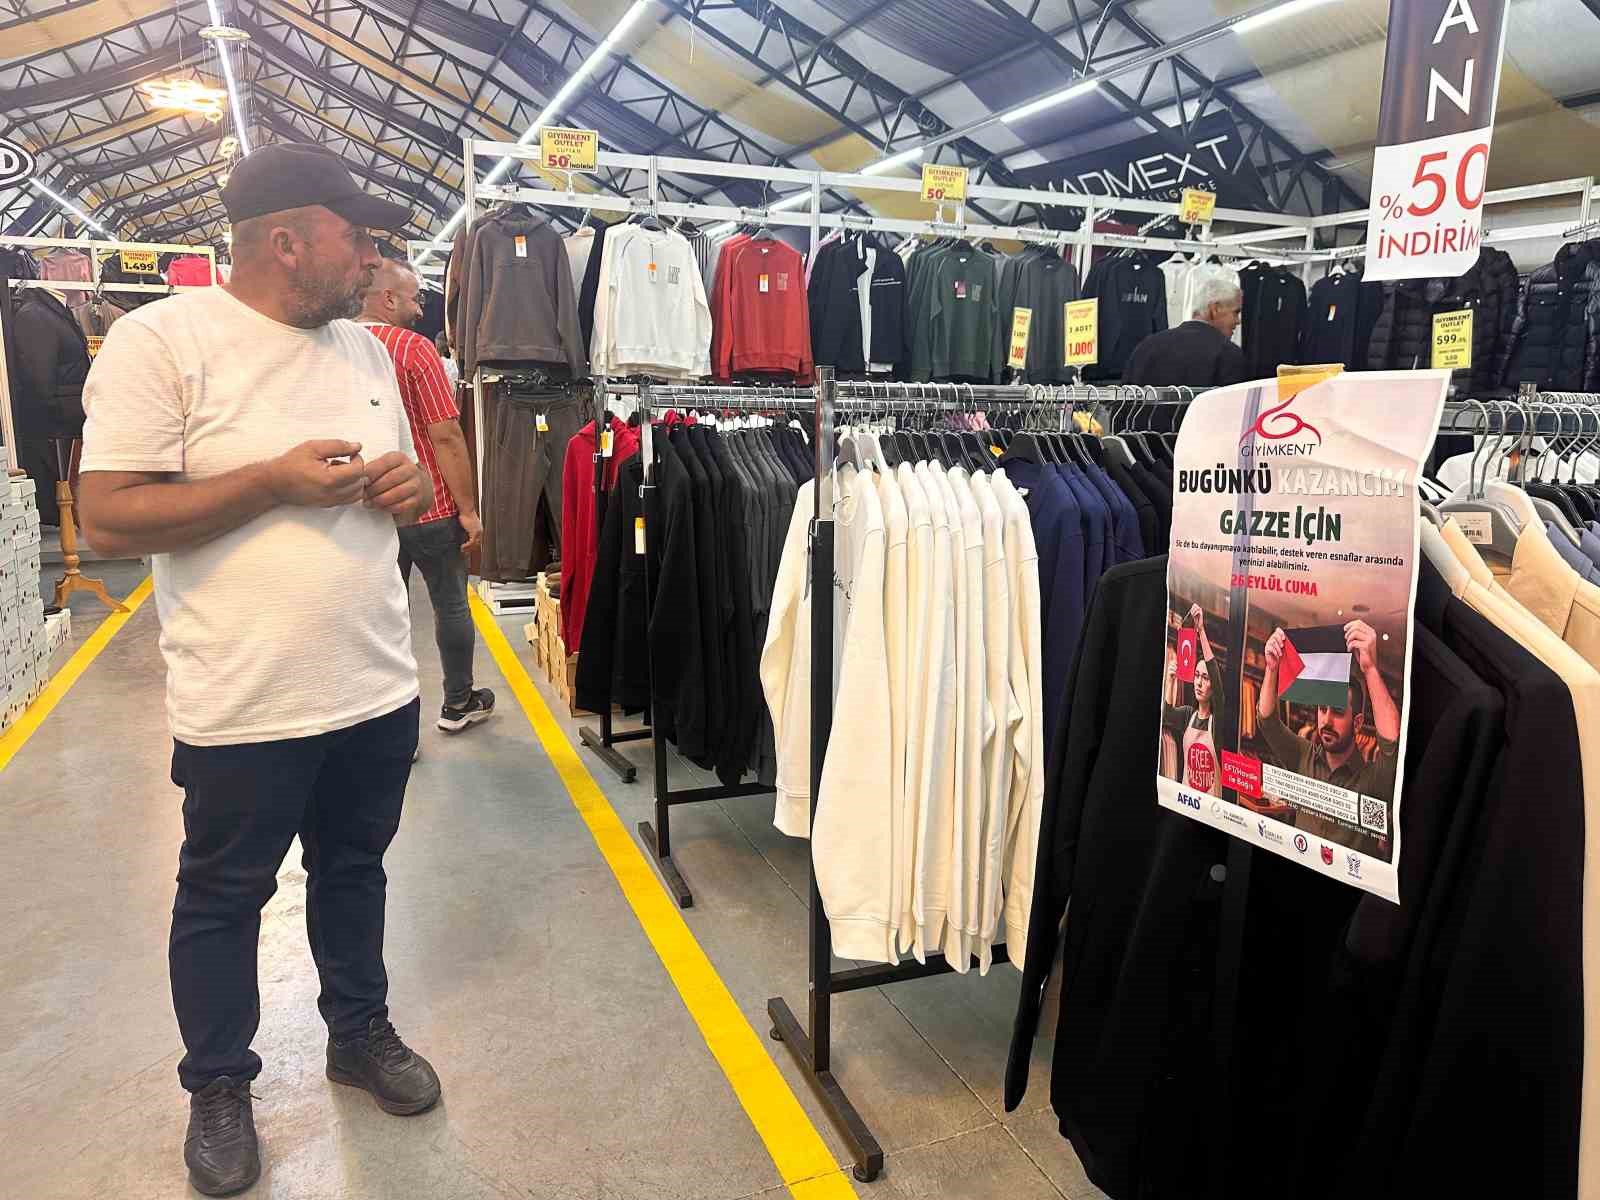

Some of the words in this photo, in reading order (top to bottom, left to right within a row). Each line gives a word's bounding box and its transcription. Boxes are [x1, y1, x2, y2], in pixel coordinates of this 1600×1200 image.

[554, 140, 584, 148] OUTLET
[1179, 462, 1272, 494] BUGÜNKÜ
[1219, 509, 1290, 539] GAZZE
[1294, 505, 1342, 545] İÇİN
[1239, 559, 1265, 567] yerinizi
[1280, 548, 1304, 557] destek
[1306, 551, 1328, 559] veren
[1329, 553, 1362, 562] esnaflar
[1365, 555, 1404, 566] arasında
[1231, 574, 1245, 588] 26
[1246, 575, 1283, 592] EYLÜL
[1285, 580, 1318, 596] CUMA
[1191, 748, 1210, 769] FREE
[1177, 792, 1201, 811] AFAD
